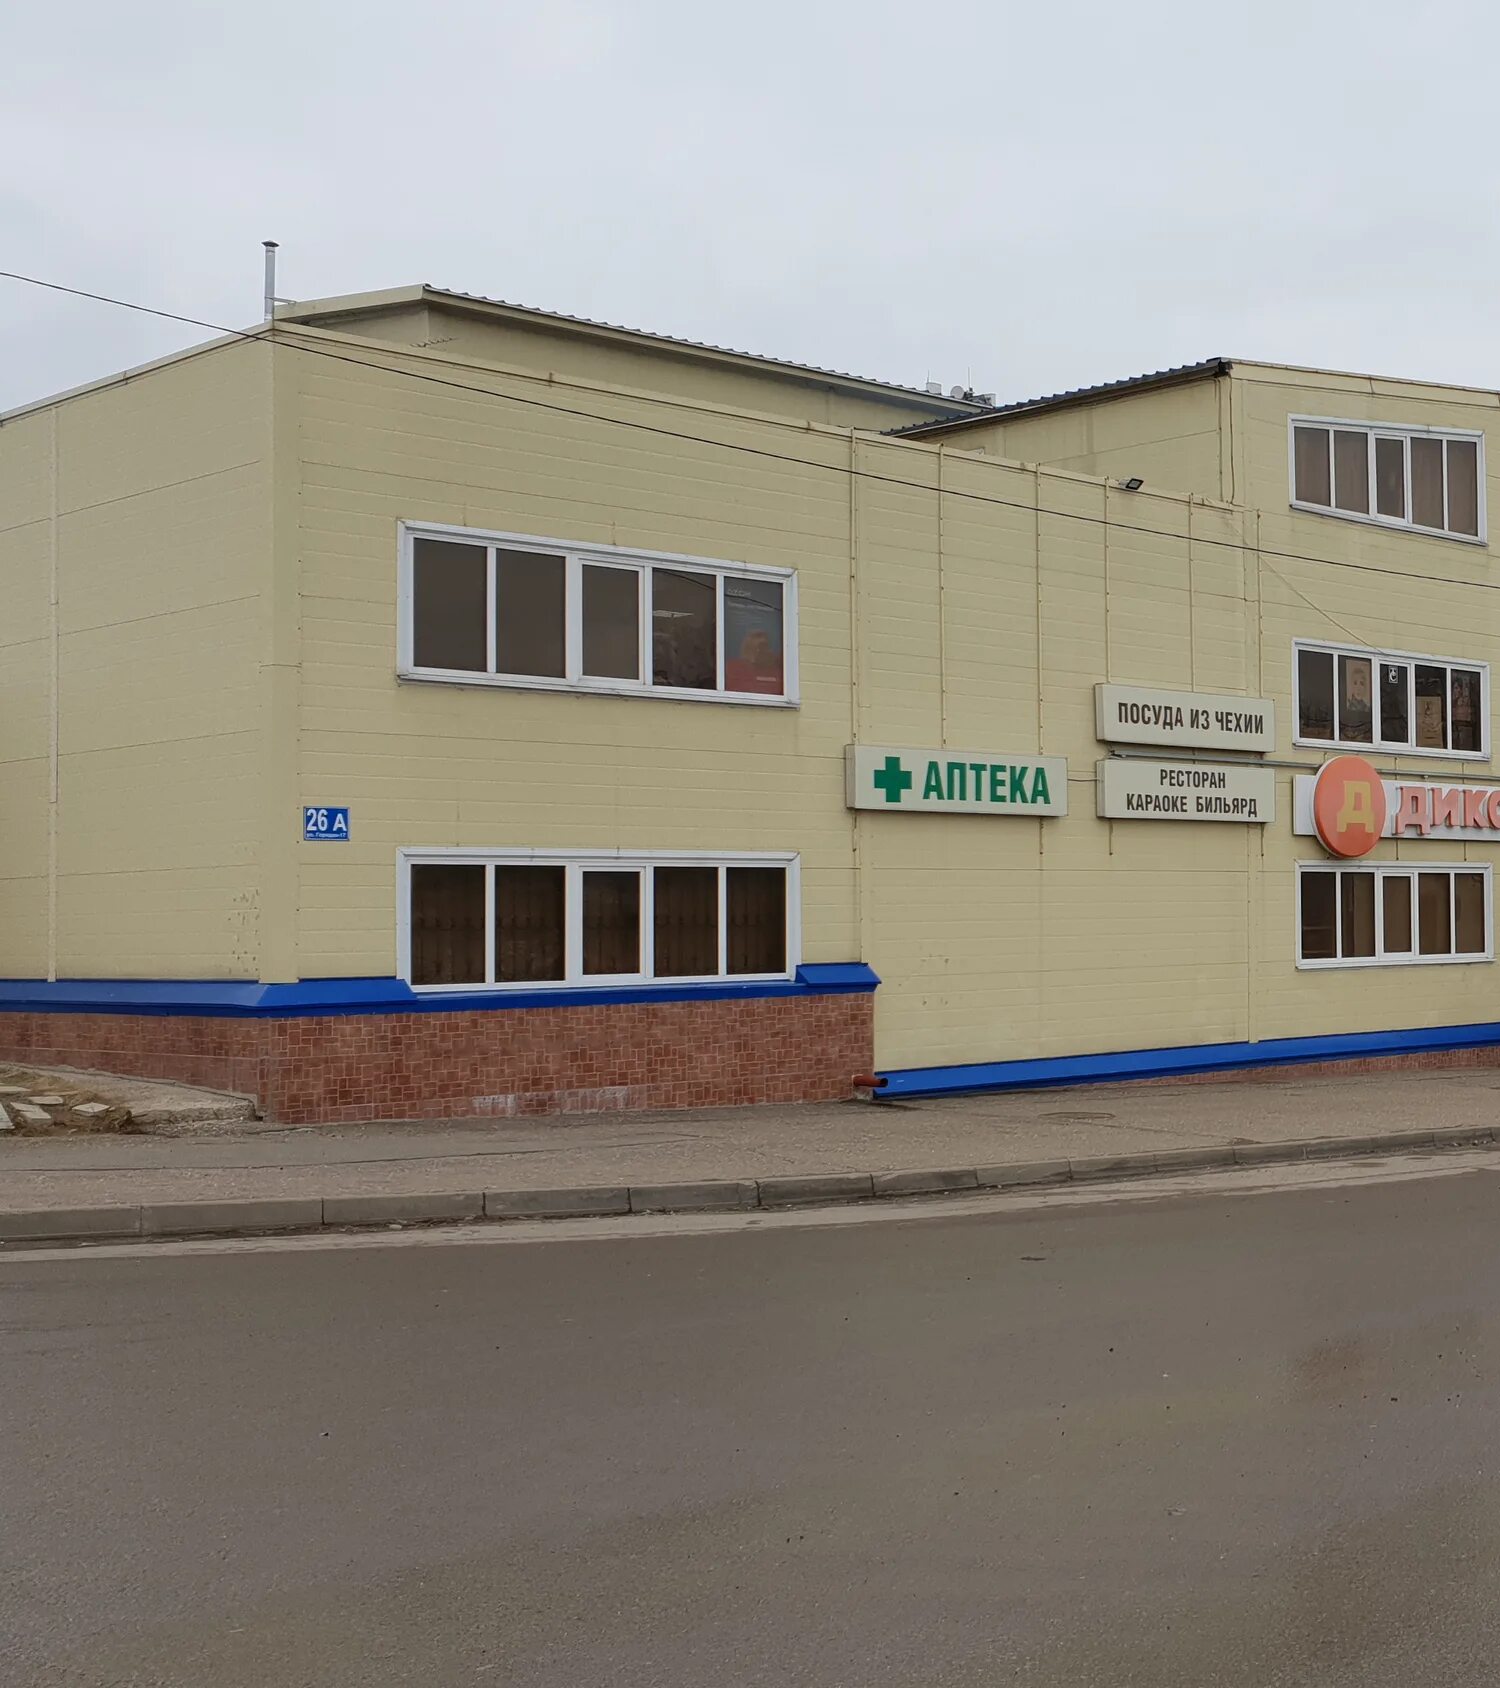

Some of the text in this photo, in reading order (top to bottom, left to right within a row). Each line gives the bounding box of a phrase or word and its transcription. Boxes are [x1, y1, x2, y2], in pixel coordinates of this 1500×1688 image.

[1118, 702, 1264, 734] ПОСУДА ИЗ ЧЕХИИ
[923, 761, 1051, 804] АПТЕКА
[1160, 769, 1226, 789] РЕСТОРАН
[1126, 793, 1257, 817] КАРАОКЕ БИЛЬЯРД
[306, 808, 347, 832] 26 А
